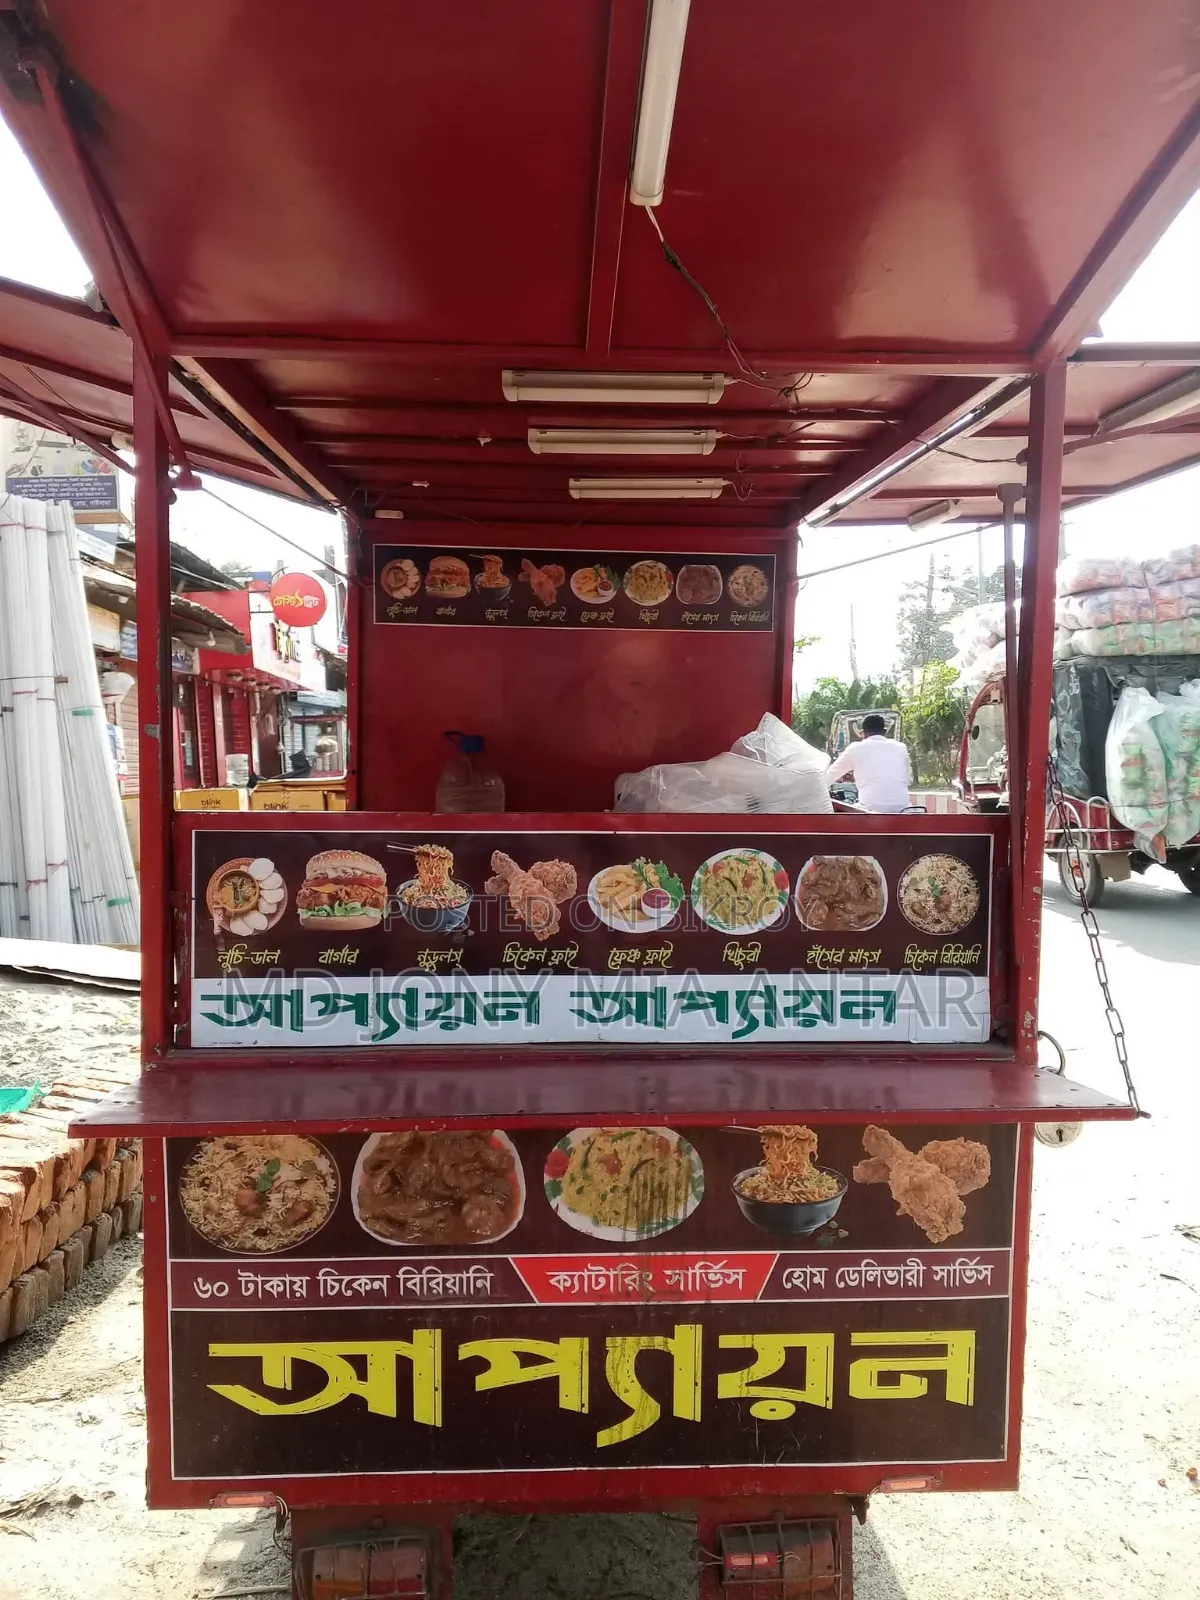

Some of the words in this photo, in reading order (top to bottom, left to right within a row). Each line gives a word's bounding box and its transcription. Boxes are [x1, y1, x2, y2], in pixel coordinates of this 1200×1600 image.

[200, 798, 221, 806] blink
[216, 943, 282, 973] লুচি-ডাল
[317, 944, 360, 966] বার্গার
[501, 942, 548, 971] চিকেন
[547, 940, 580, 970] ফ্রাই
[607, 945, 642, 971] ফ্রেঞ্চ
[642, 940, 676, 970] ফ্রাই
[806, 943, 844, 969] হাঁসের
[848, 948, 882, 971] মাংস
[903, 942, 938, 971] চিকেন
[939, 943, 983, 966] বিরিয়ানি
[193, 1276, 229, 1299] ৬০
[237, 1268, 311, 1299] টাকায়
[317, 1267, 391, 1298] চিকেন
[396, 1264, 495, 1297] বিরিয়ানি
[545, 1262, 656, 1294] ক্যাটারিং
[663, 1260, 749, 1292] সার্ভিস
[782, 1266, 828, 1293] হোম
[835, 1259, 927, 1290] ডেলিভারী
[933, 1257, 995, 1288] সার্ভিস
